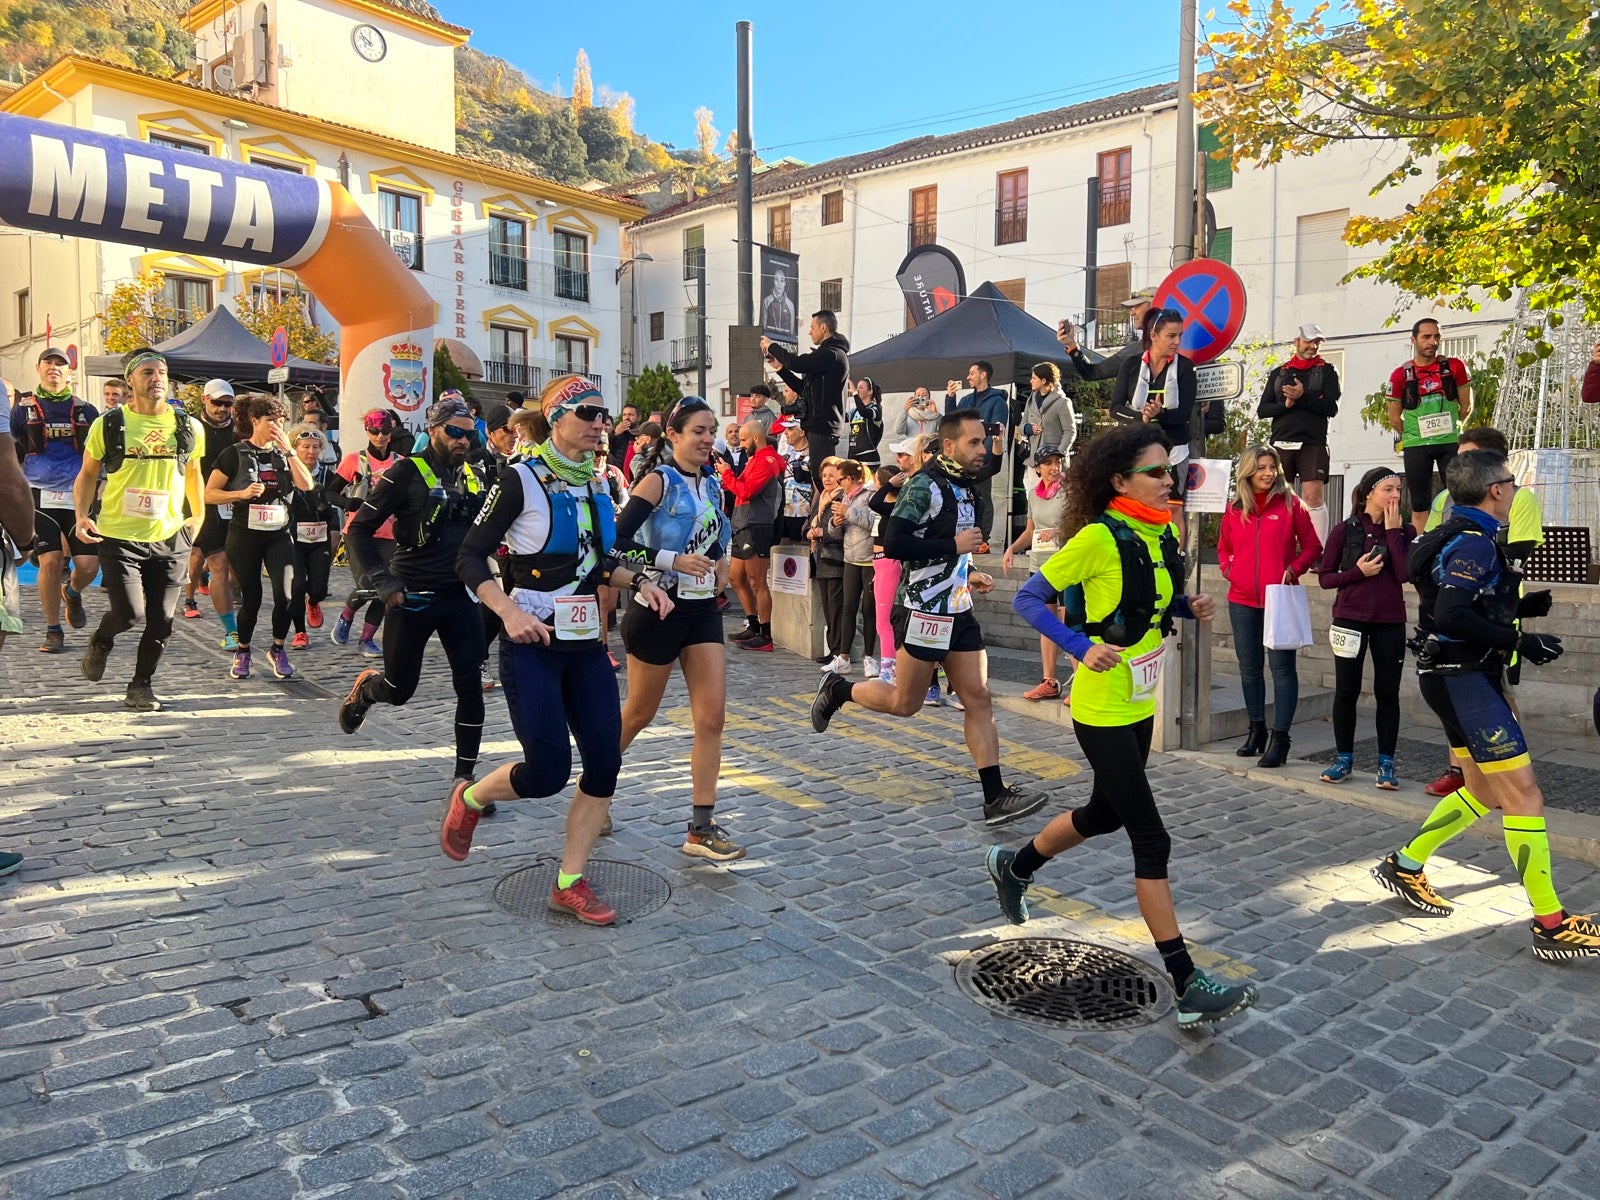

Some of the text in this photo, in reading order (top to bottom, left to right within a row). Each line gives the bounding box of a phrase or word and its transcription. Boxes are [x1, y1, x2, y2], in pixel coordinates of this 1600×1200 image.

[28, 134, 275, 253] META
[1426, 419, 1441, 428] 262
[53, 491, 64, 500] 72
[138, 496, 151, 508] 79
[258, 511, 273, 521] 104
[306, 528, 316, 536] 34
[571, 606, 587, 622] 26
[920, 621, 938, 636] 170
[1142, 660, 1158, 685] 172
